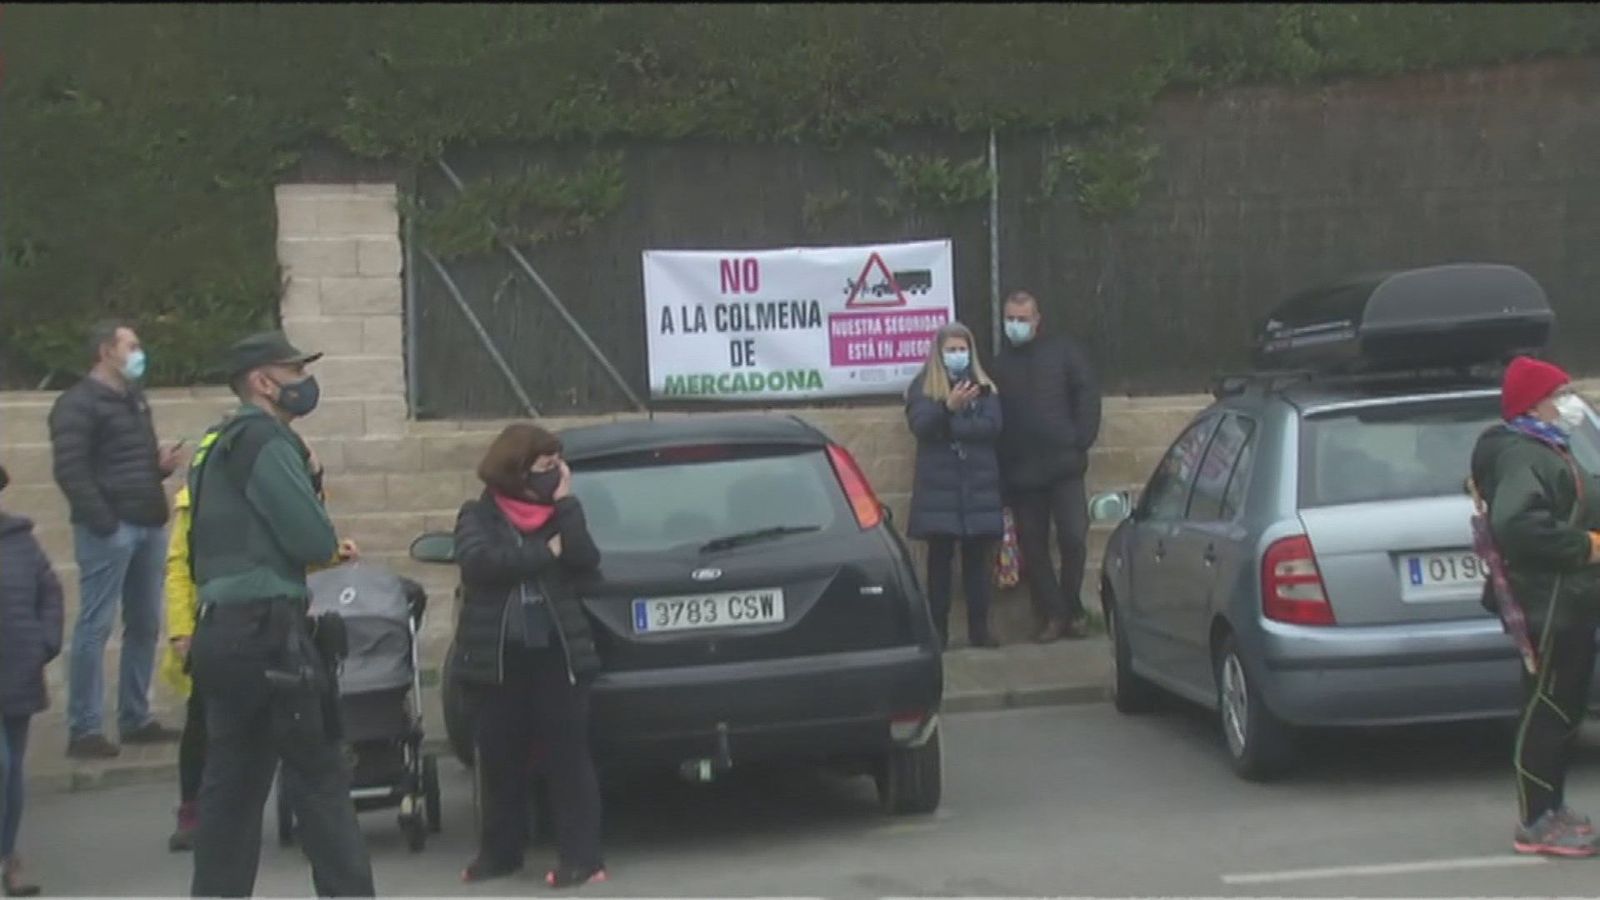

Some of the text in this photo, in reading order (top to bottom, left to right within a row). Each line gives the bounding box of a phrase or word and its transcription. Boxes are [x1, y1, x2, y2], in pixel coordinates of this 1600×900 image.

[720, 257, 760, 294] NO
[661, 300, 822, 334] A LA COLMENA
[831, 317, 882, 336] NUESTRA
[730, 340, 755, 367] DE
[848, 339, 876, 360] ESTÁ
[878, 340, 894, 358] EN
[664, 369, 823, 395] MERCADONA
[655, 595, 774, 626] 3783 CSW
